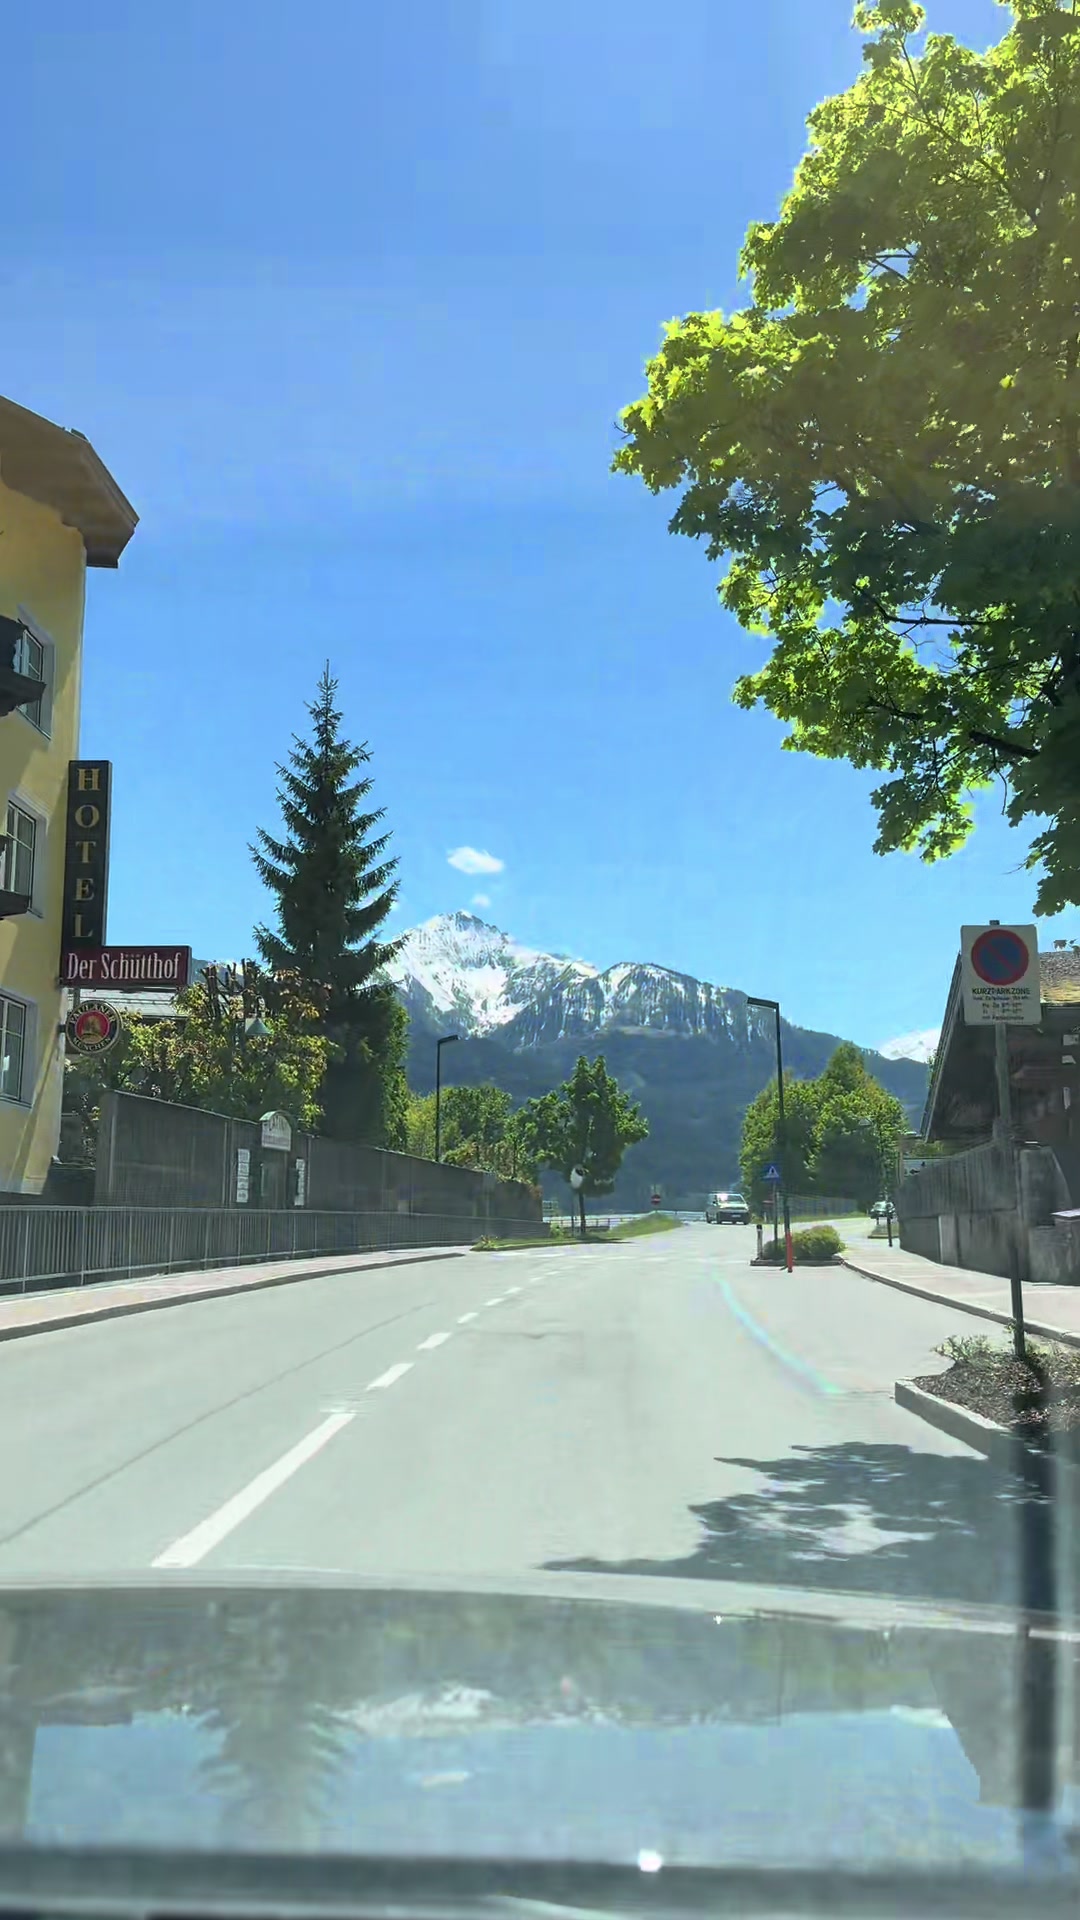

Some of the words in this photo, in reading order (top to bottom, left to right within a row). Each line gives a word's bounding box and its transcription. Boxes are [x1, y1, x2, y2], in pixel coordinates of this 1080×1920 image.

[72, 768, 100, 938] HOTEL
[67, 952, 97, 979] Der
[101, 952, 181, 979] Schütthof
[972, 987, 1031, 995] KURZPARKZONE
[69, 1004, 116, 1024] PAULANER
